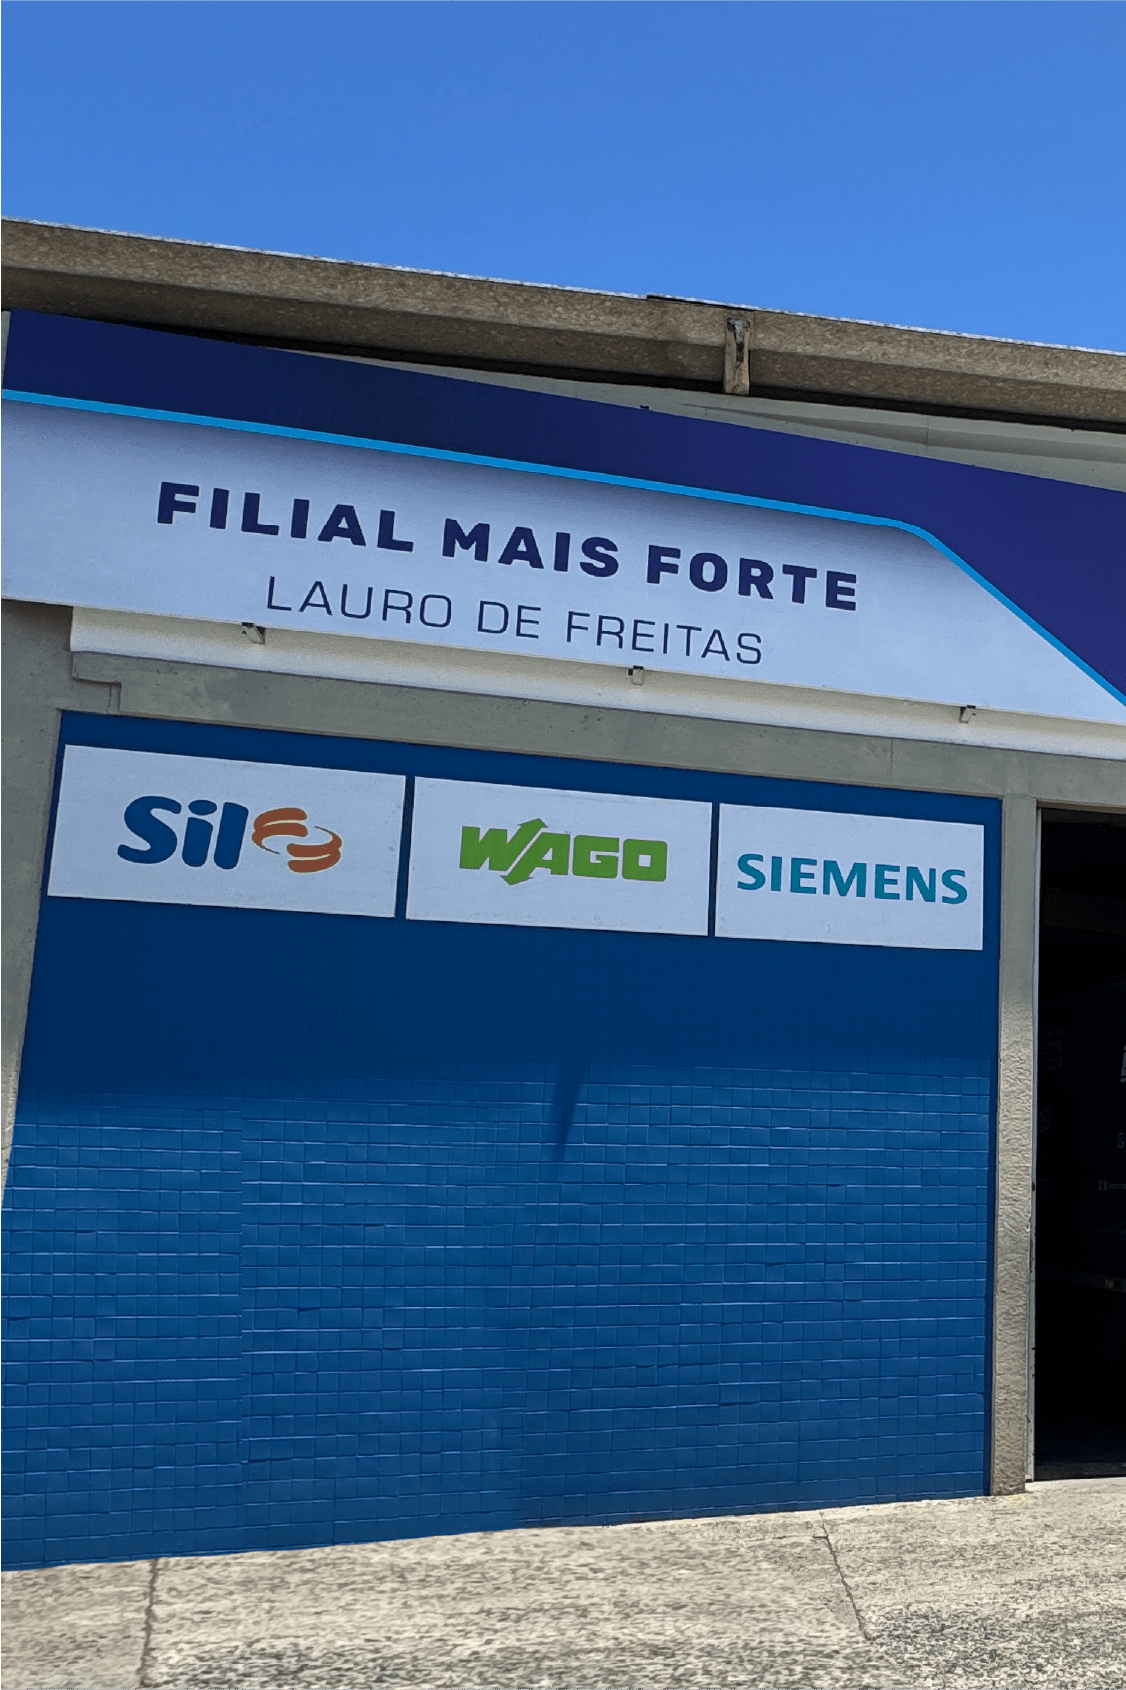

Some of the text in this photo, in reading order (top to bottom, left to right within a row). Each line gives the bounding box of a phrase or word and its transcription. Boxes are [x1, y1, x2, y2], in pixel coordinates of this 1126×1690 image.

[157, 481, 857, 612] FILIAL MAIS FORTE
[267, 575, 762, 665] LAURO DE FREITAS
[117, 795, 249, 870] Sil
[459, 818, 668, 886] WAGO
[736, 852, 969, 905] SIEMENS
